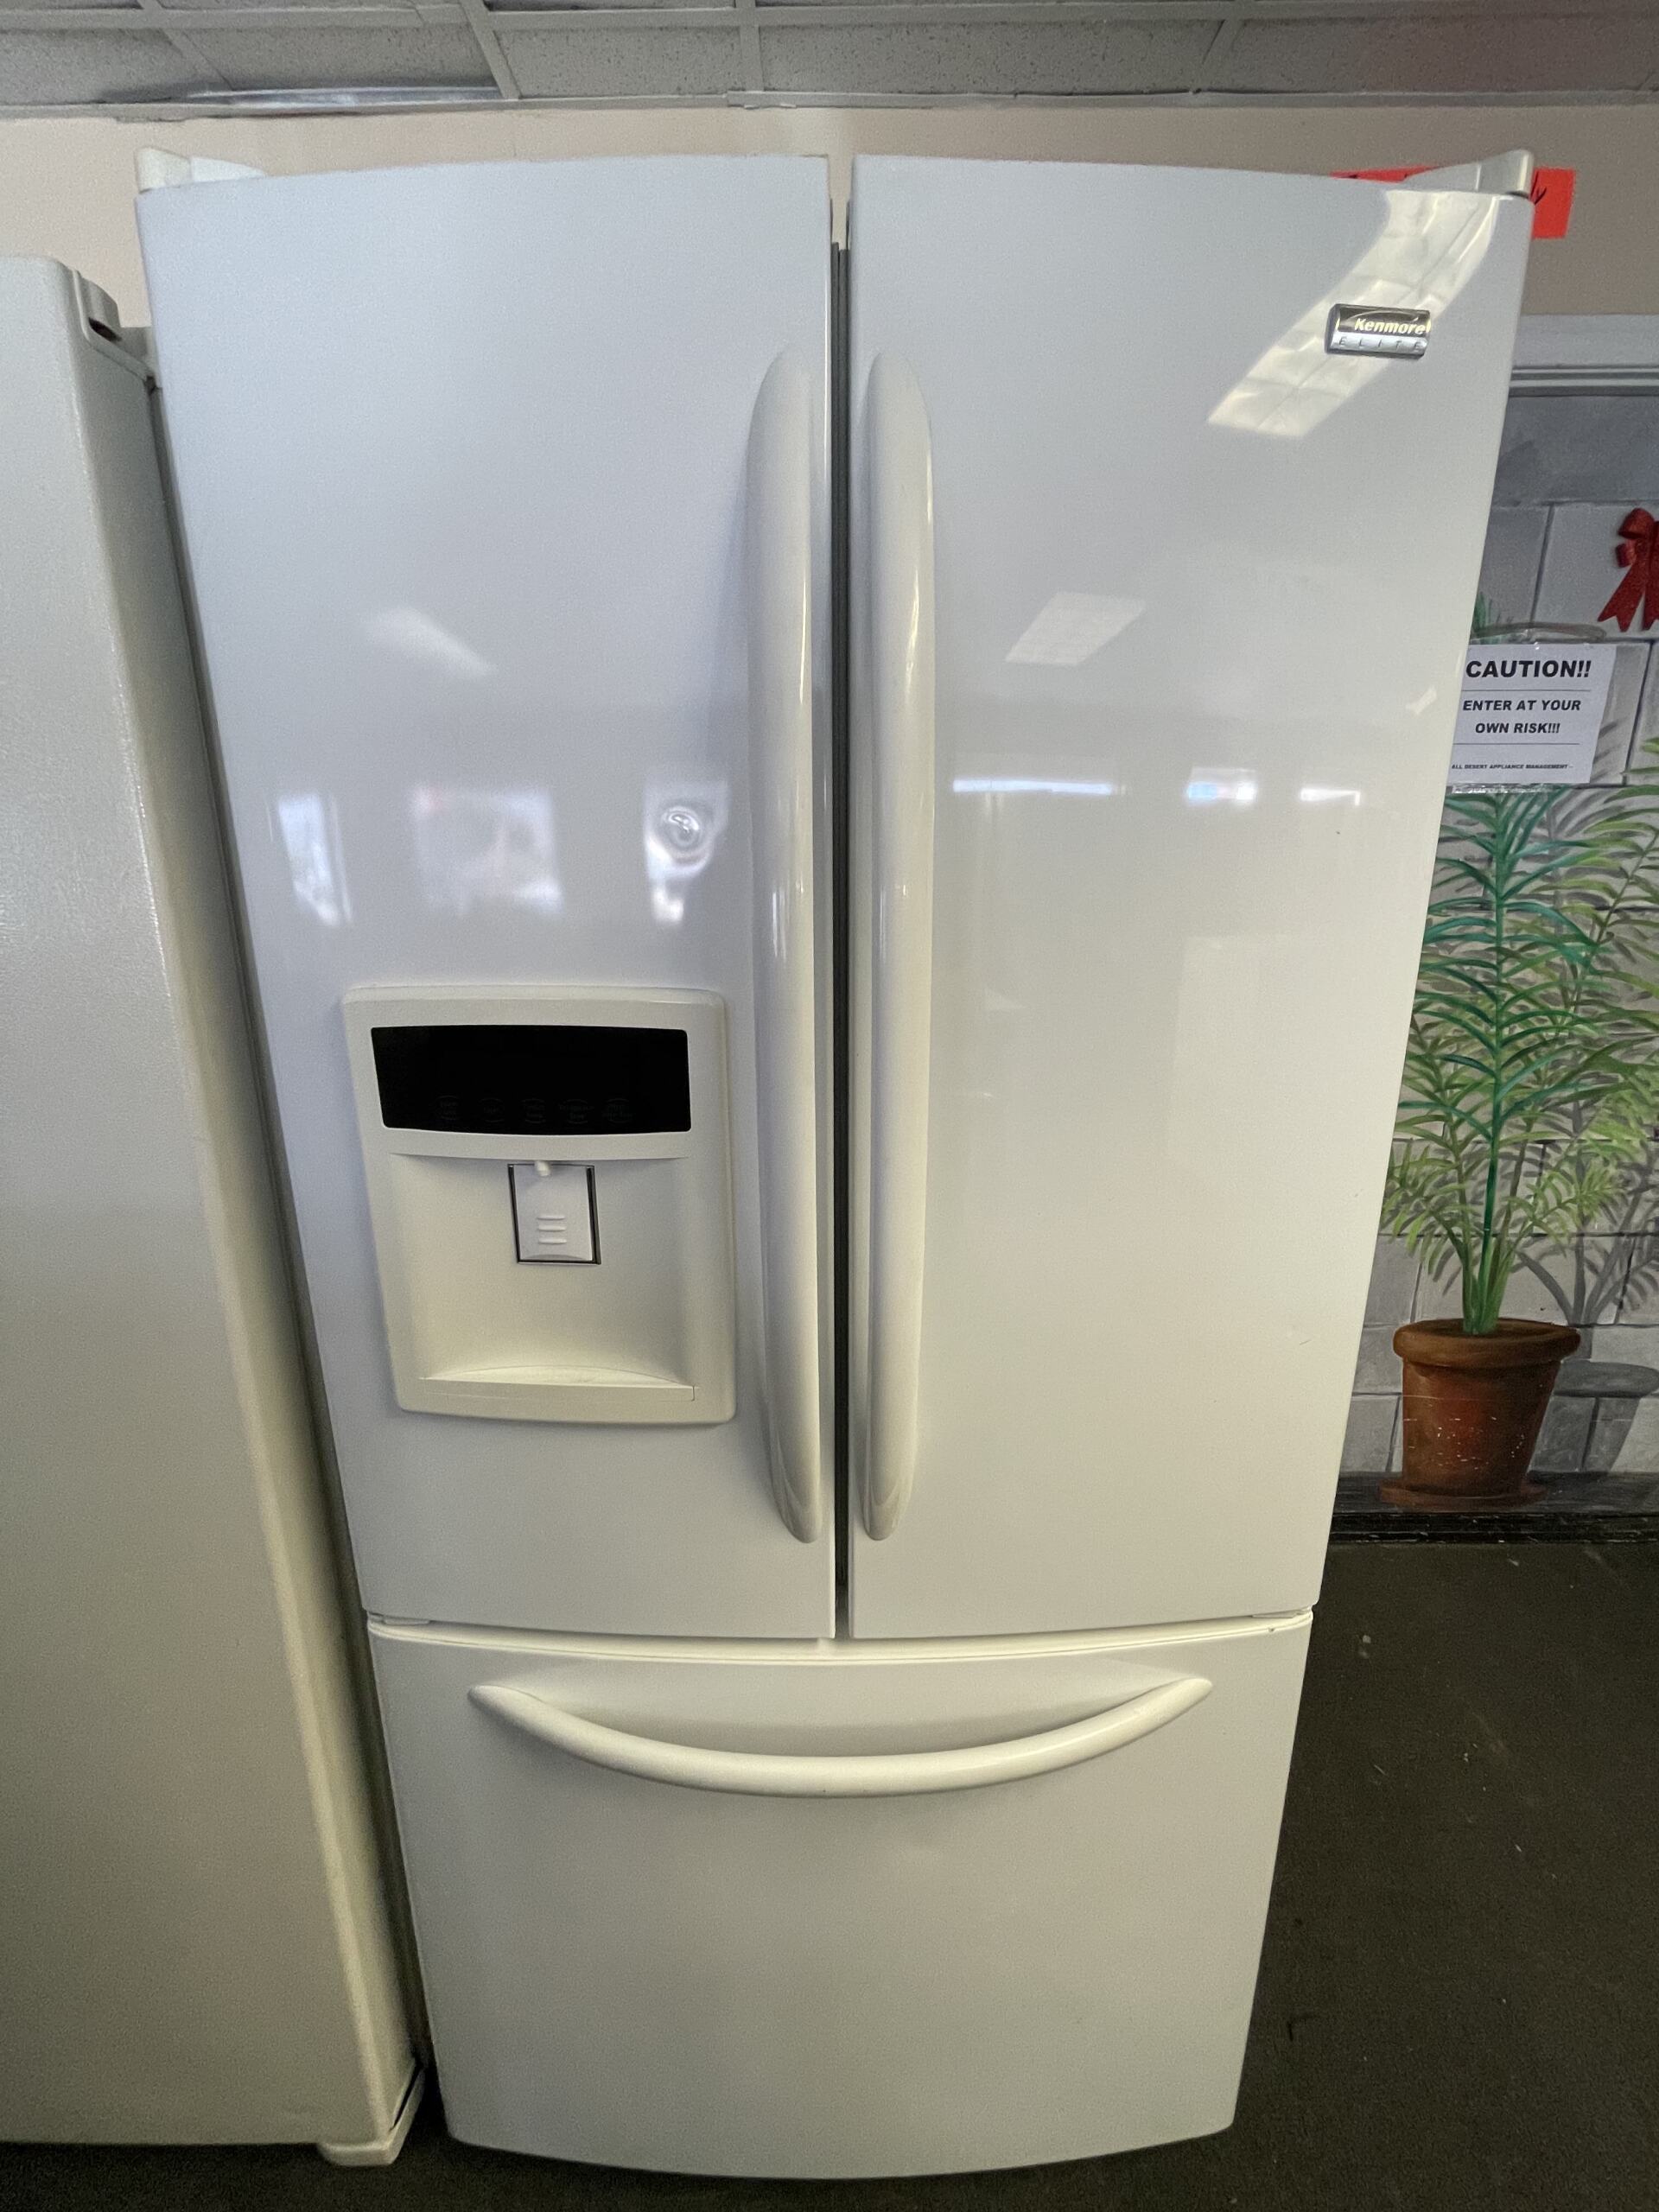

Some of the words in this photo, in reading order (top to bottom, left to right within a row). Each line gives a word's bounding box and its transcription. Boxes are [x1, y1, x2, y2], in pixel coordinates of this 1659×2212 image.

[1354, 317, 1426, 335] Kenmore
[1465, 660, 1592, 678] CAUTION!!
[1462, 700, 1511, 711] ENTER
[1516, 700, 1537, 711] AT
[1542, 700, 1581, 711] YOUR
[1475, 722, 1509, 734] OWN
[1513, 722, 1560, 734] RISK!!!
